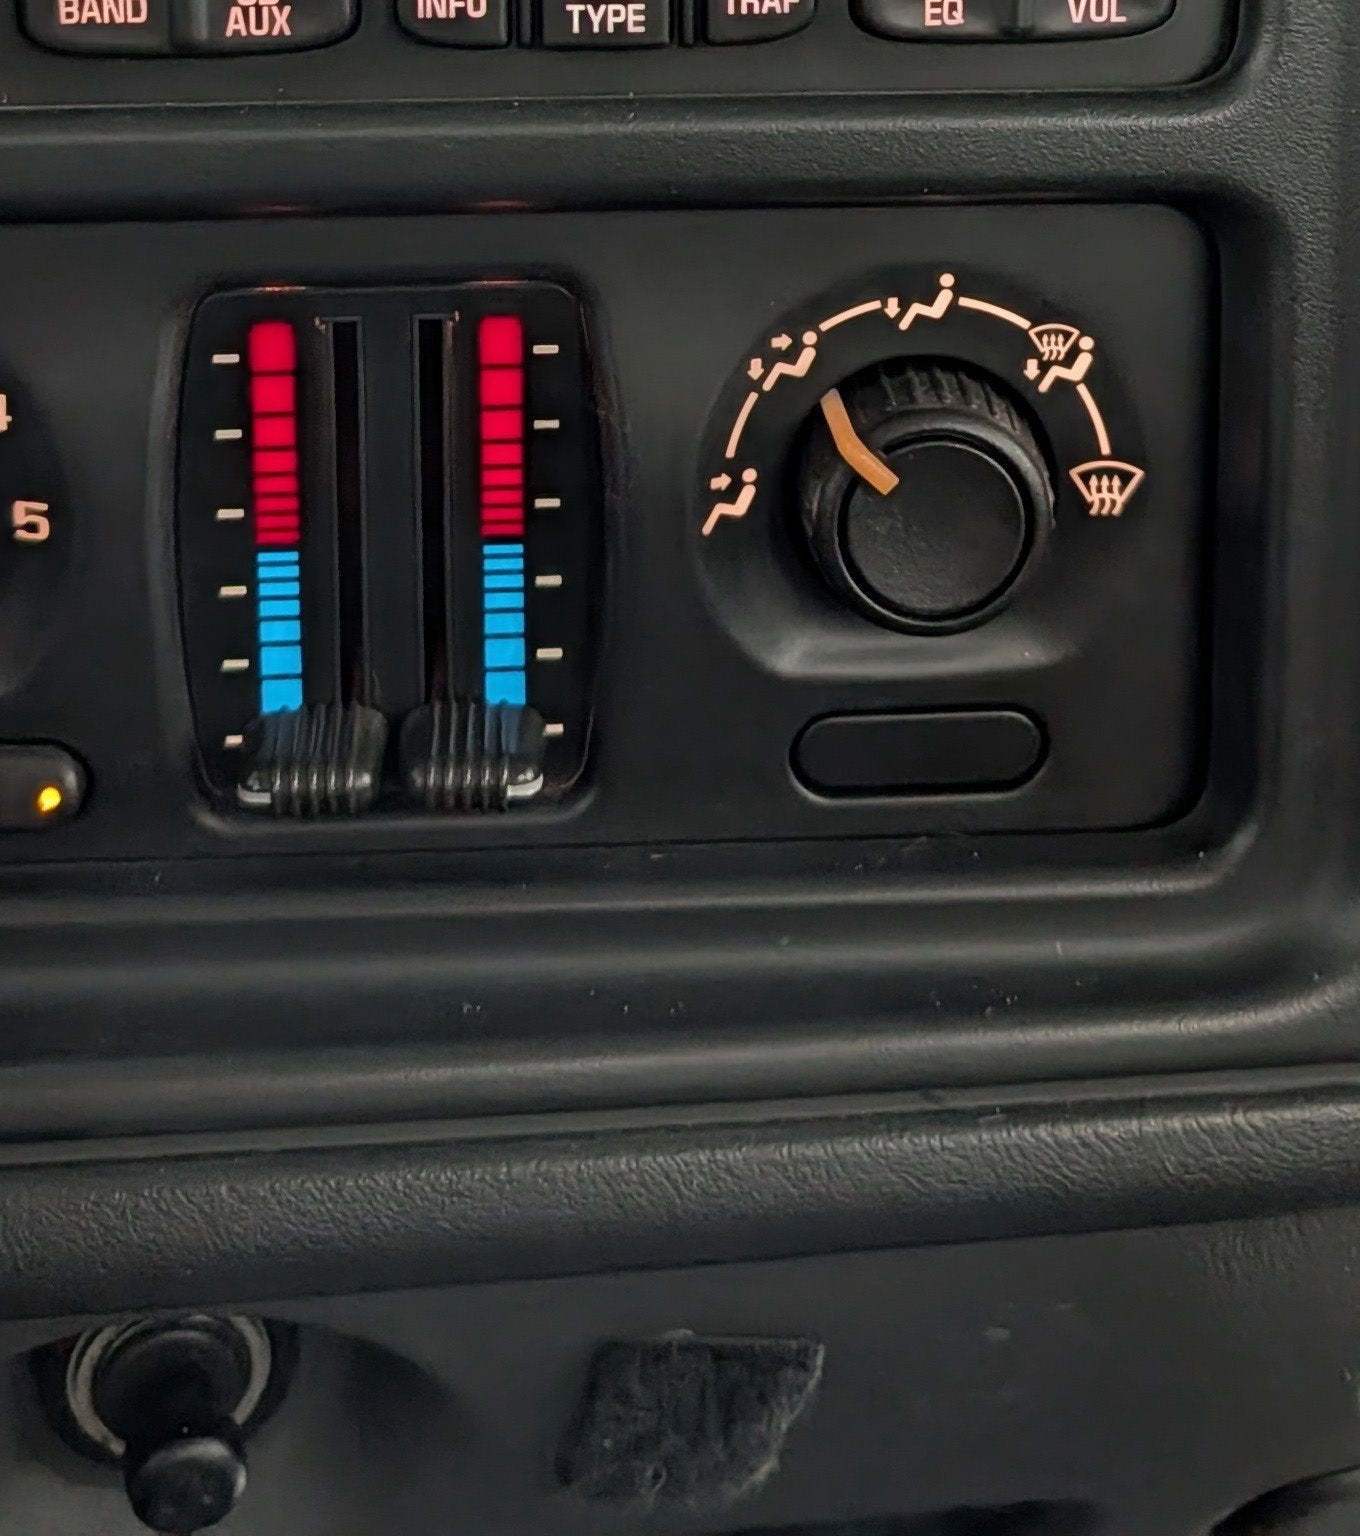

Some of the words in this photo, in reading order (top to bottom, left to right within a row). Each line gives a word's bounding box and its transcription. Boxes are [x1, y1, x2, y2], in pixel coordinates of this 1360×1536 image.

[225, 6, 292, 38] AUX
[565, 3, 646, 34] TYPE
[12, 500, 50, 541] 5
